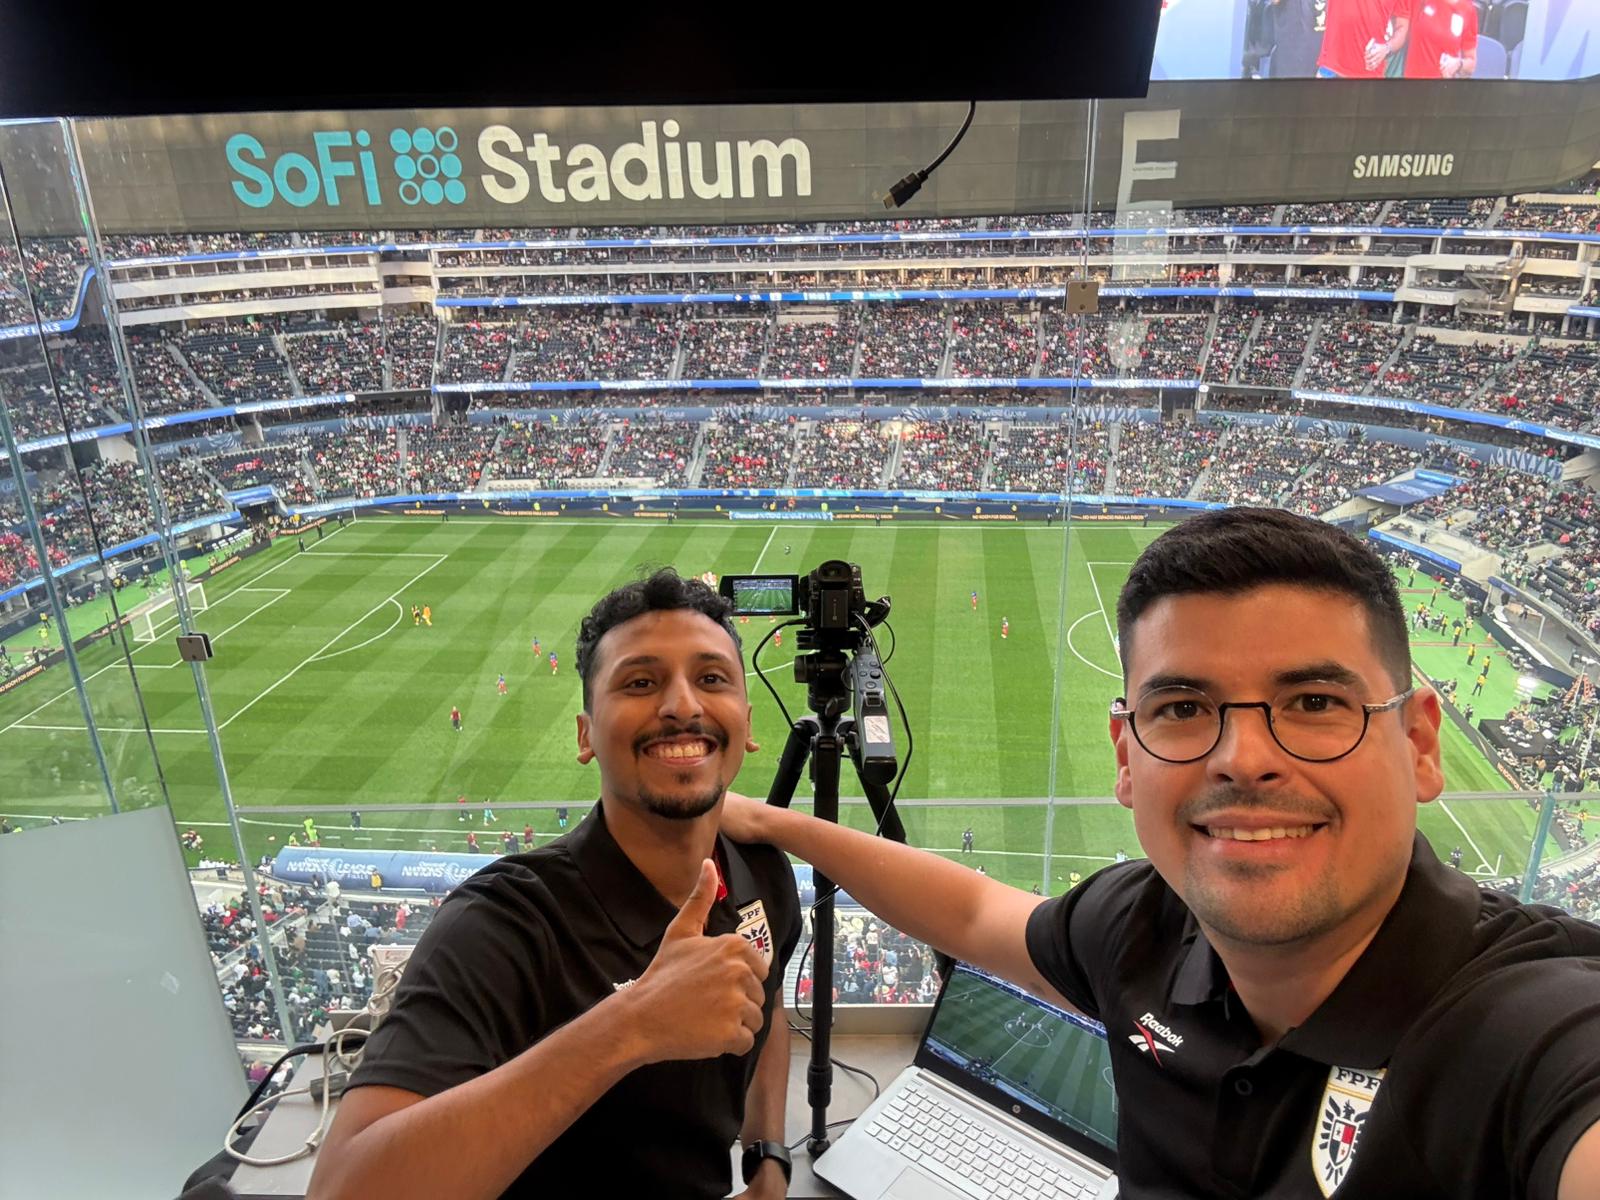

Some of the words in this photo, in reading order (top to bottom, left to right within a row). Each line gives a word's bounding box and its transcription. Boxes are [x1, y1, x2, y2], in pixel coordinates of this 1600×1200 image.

[225, 129, 382, 209] SoFi
[477, 119, 812, 204] Stadium
[1352, 153, 1454, 179] SAMSUNG
[1140, 1012, 1184, 1047] Reebok
[1335, 1069, 1382, 1091] FPF
